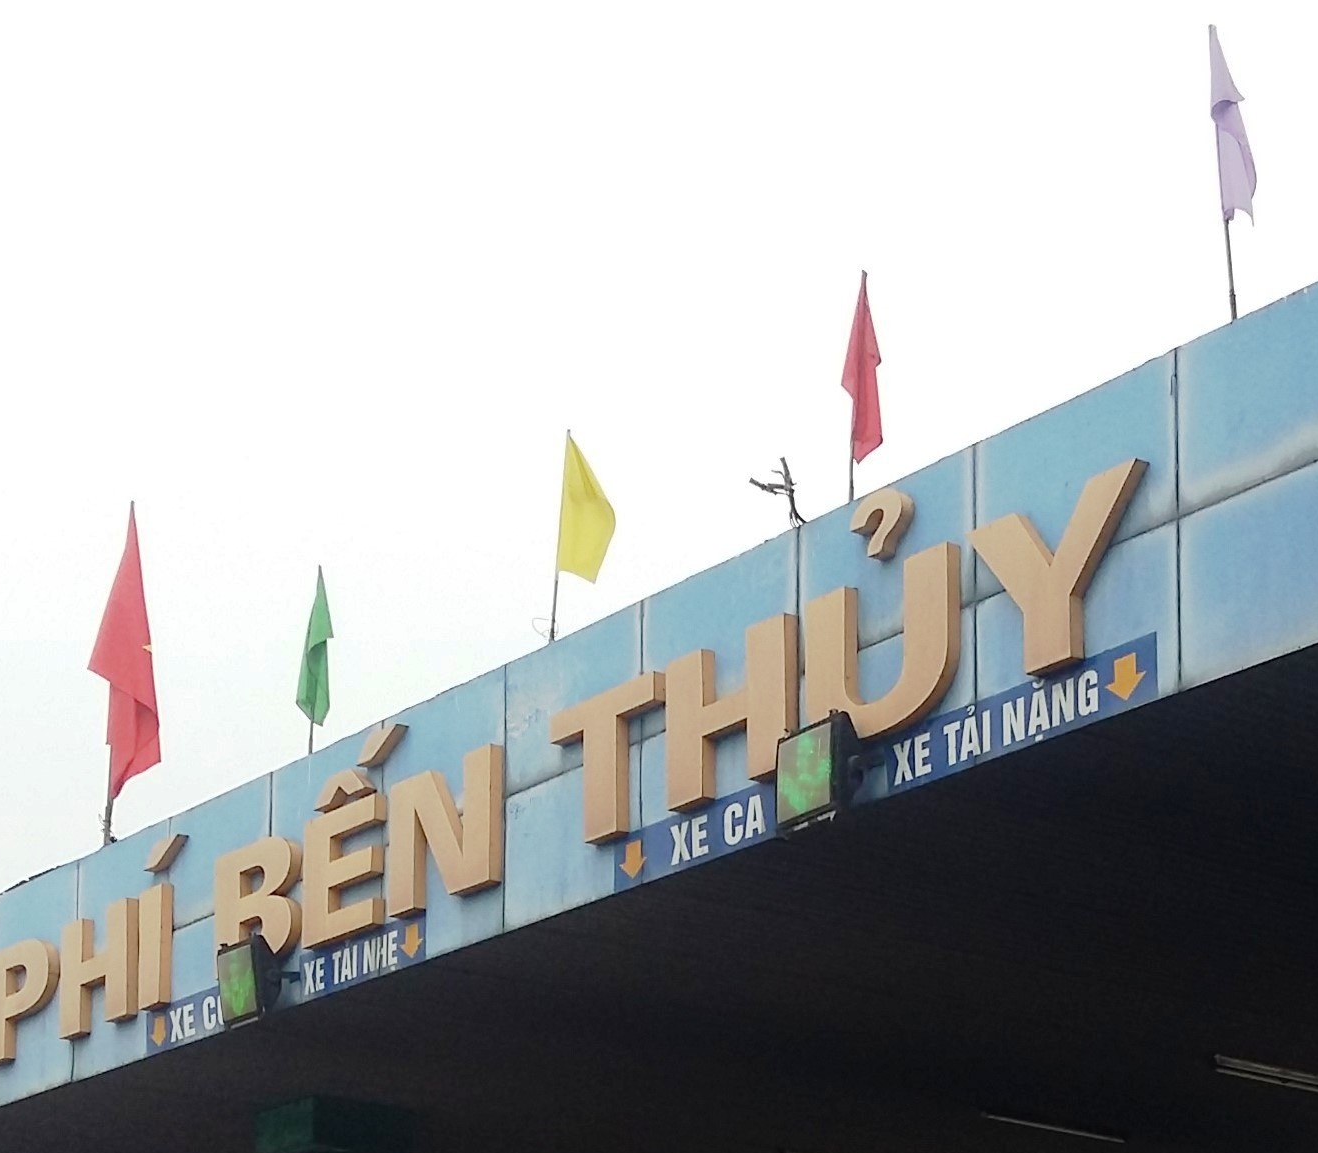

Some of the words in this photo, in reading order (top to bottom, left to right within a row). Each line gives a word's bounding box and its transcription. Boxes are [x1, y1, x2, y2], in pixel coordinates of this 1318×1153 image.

[215, 723, 504, 982] BẾN
[549, 457, 1150, 845] THỦY
[892, 737, 932, 787] XE
[944, 704, 992, 767] TẢI
[1001, 669, 1101, 746] NẶNG
[669, 812, 709, 866] XE
[303, 957, 325, 996] XE
[332, 940, 358, 985] TẢI
[362, 929, 398, 975] NHẸ
[169, 1003, 196, 1043] XE
